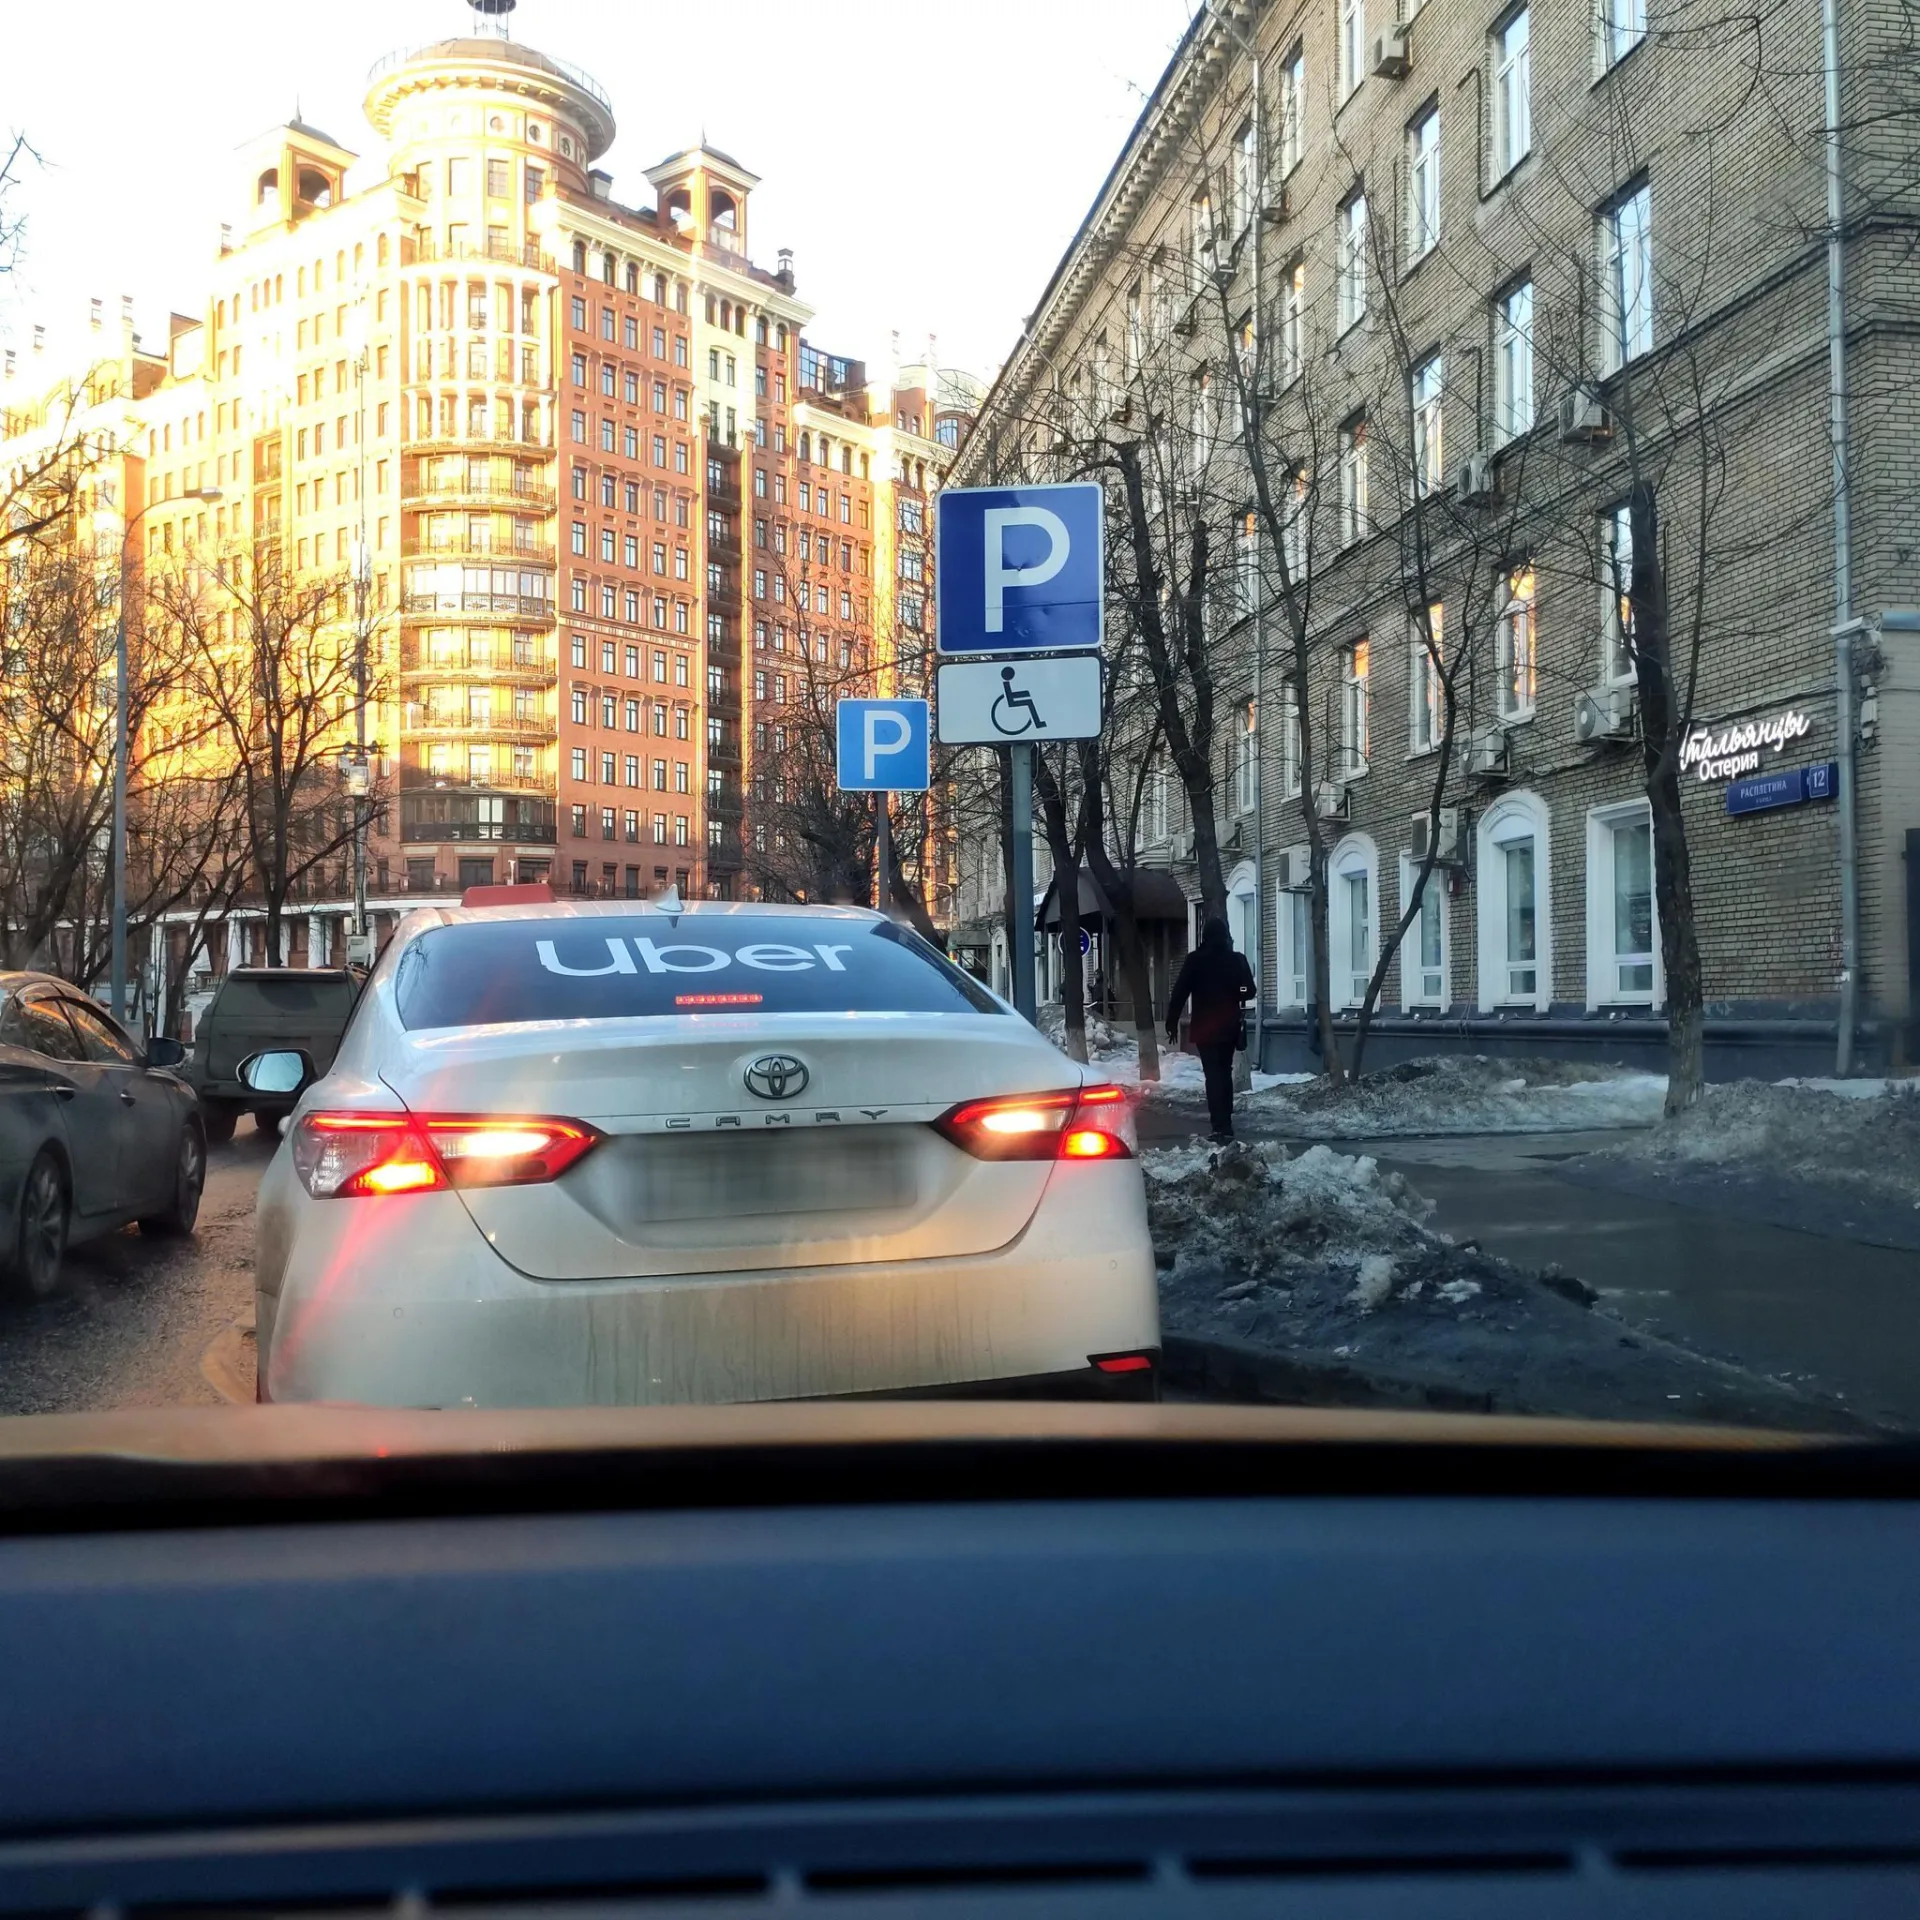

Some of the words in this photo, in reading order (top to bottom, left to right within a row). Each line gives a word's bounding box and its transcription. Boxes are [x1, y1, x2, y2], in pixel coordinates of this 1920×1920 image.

[984, 506, 1070, 633] P
[864, 710, 912, 780] P
[1699, 751, 1758, 781] Остерия
[1812, 770, 1825, 788] 12
[1741, 780, 1787, 798] РАСПЛЕТИНА
[535, 937, 853, 976] Uber
[665, 1110, 888, 1129] CAMRY
